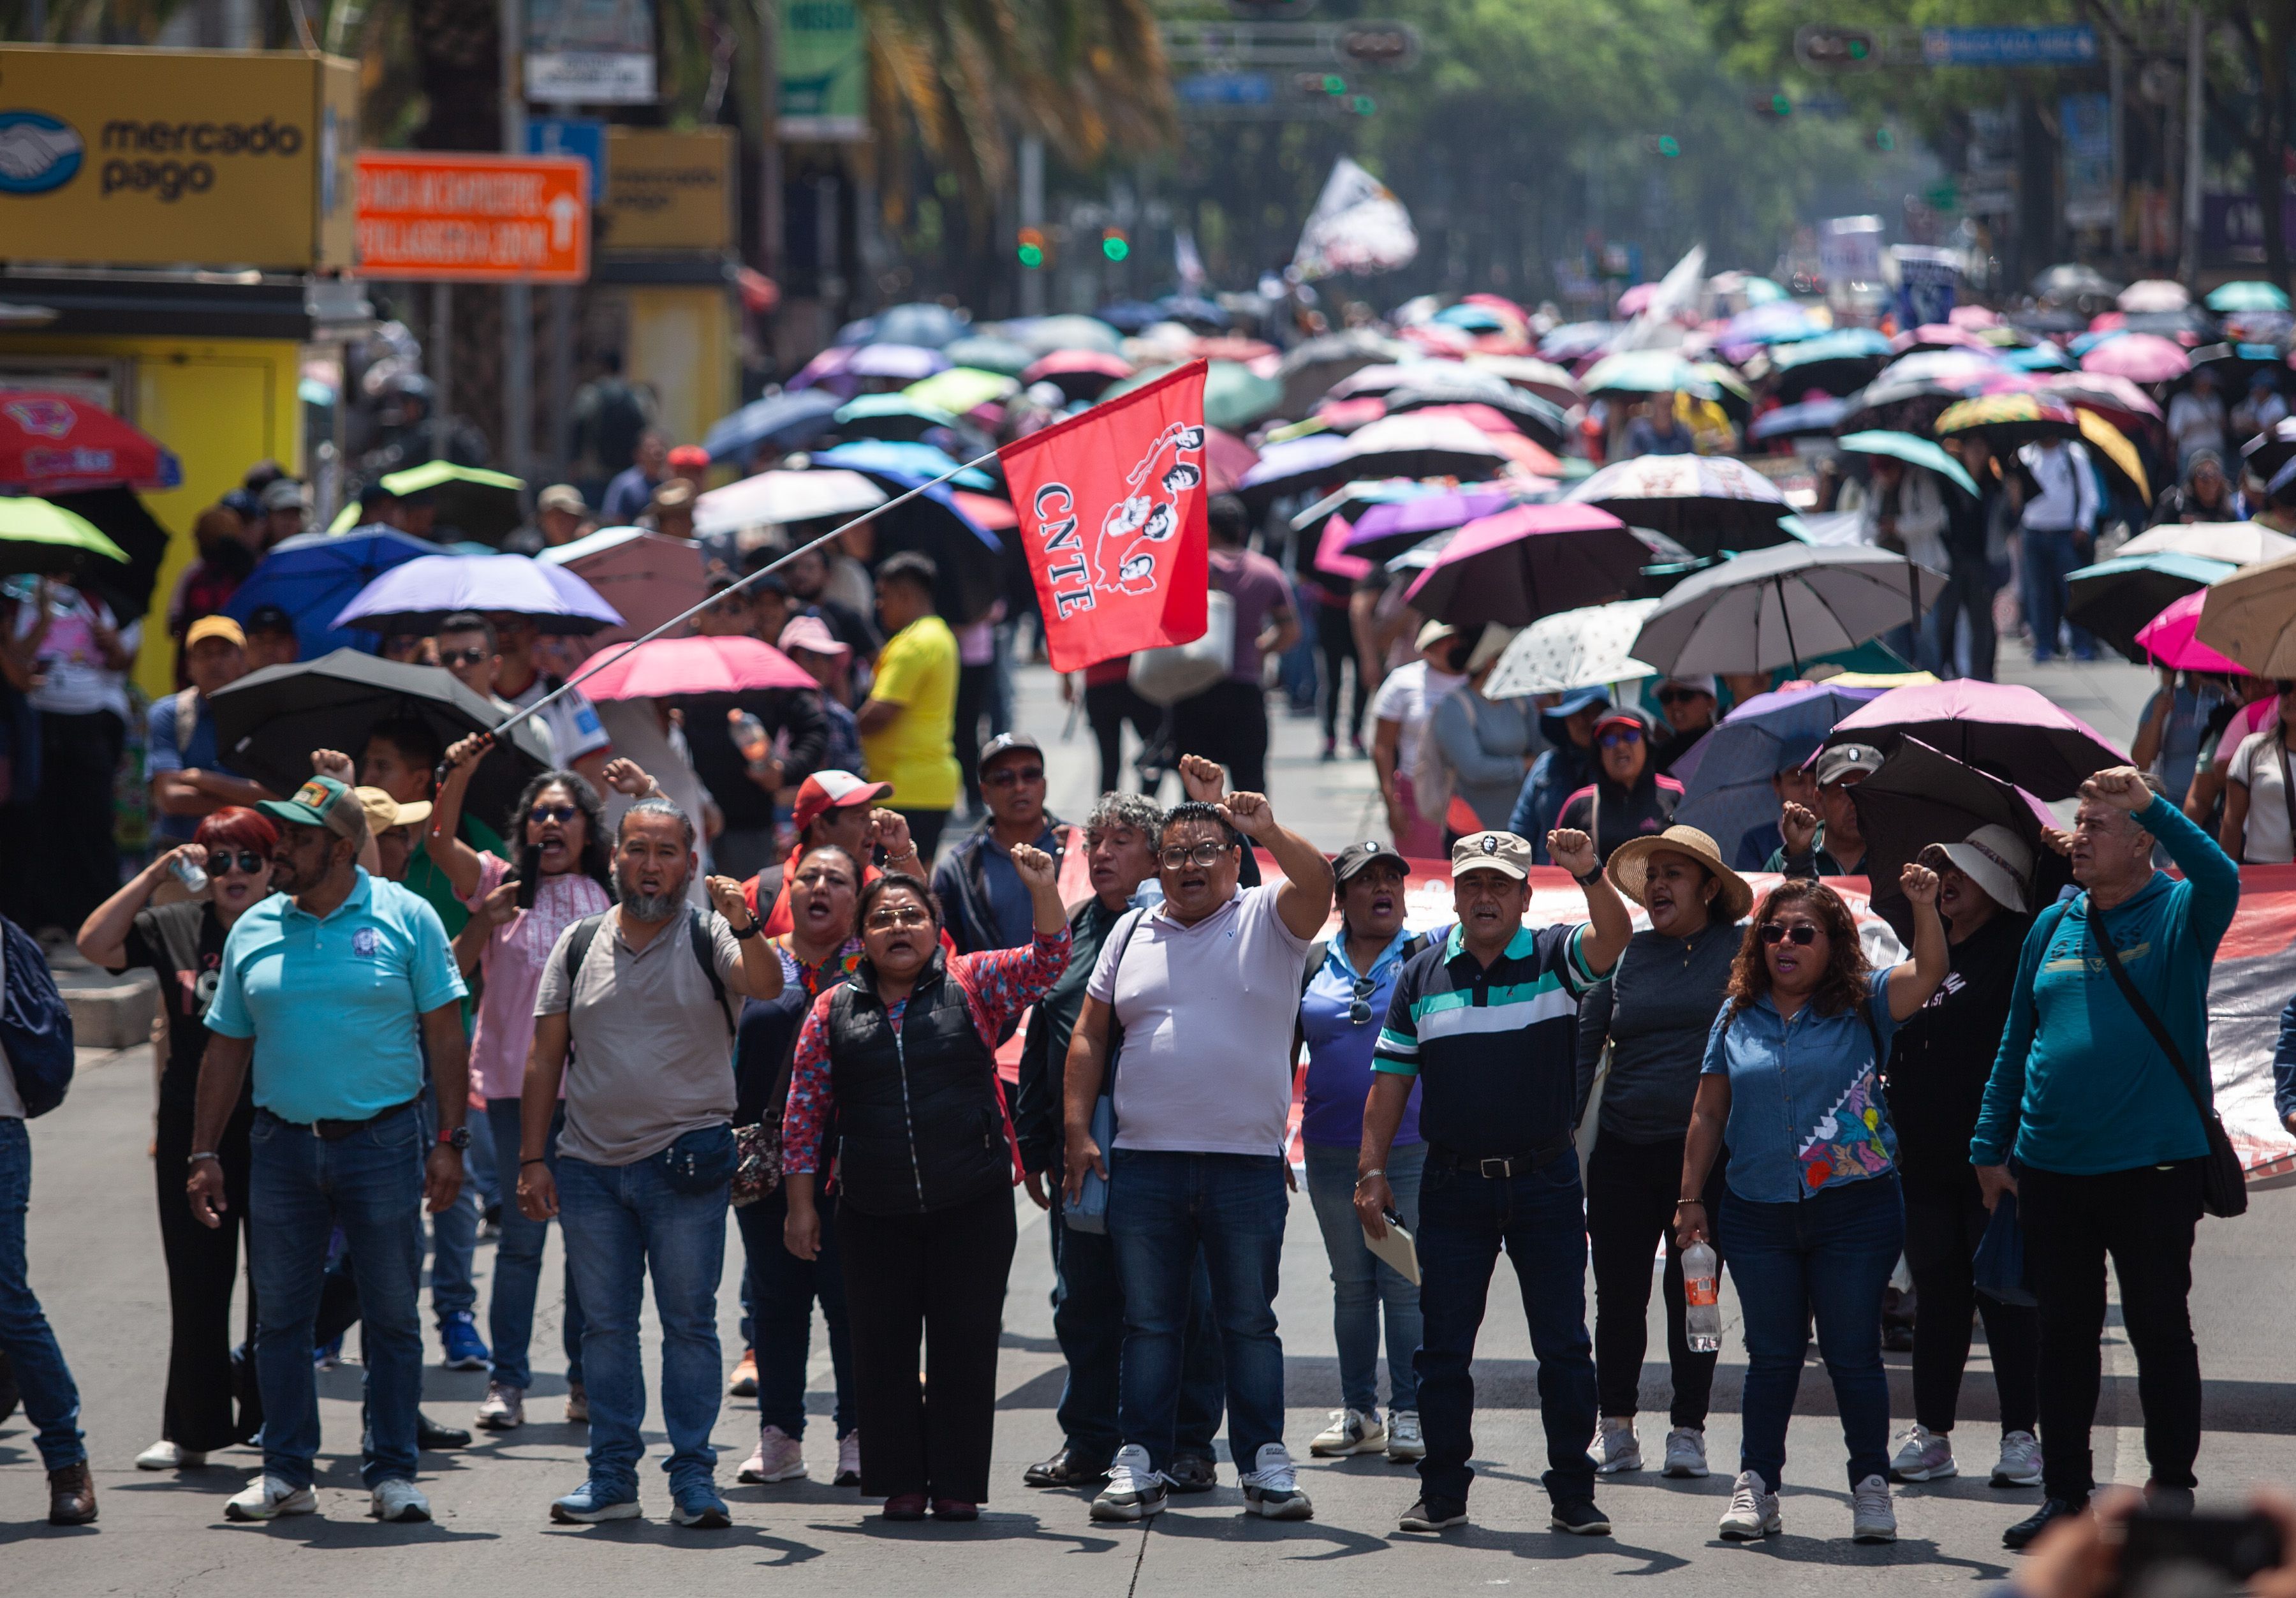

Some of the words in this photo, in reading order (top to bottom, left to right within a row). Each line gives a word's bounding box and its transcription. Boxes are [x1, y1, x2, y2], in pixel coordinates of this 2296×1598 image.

[100, 117, 303, 156] mercado
[100, 158, 216, 203] pago
[1033, 481, 1097, 620] CNTE
[2050, 926, 2142, 959] GUSS
